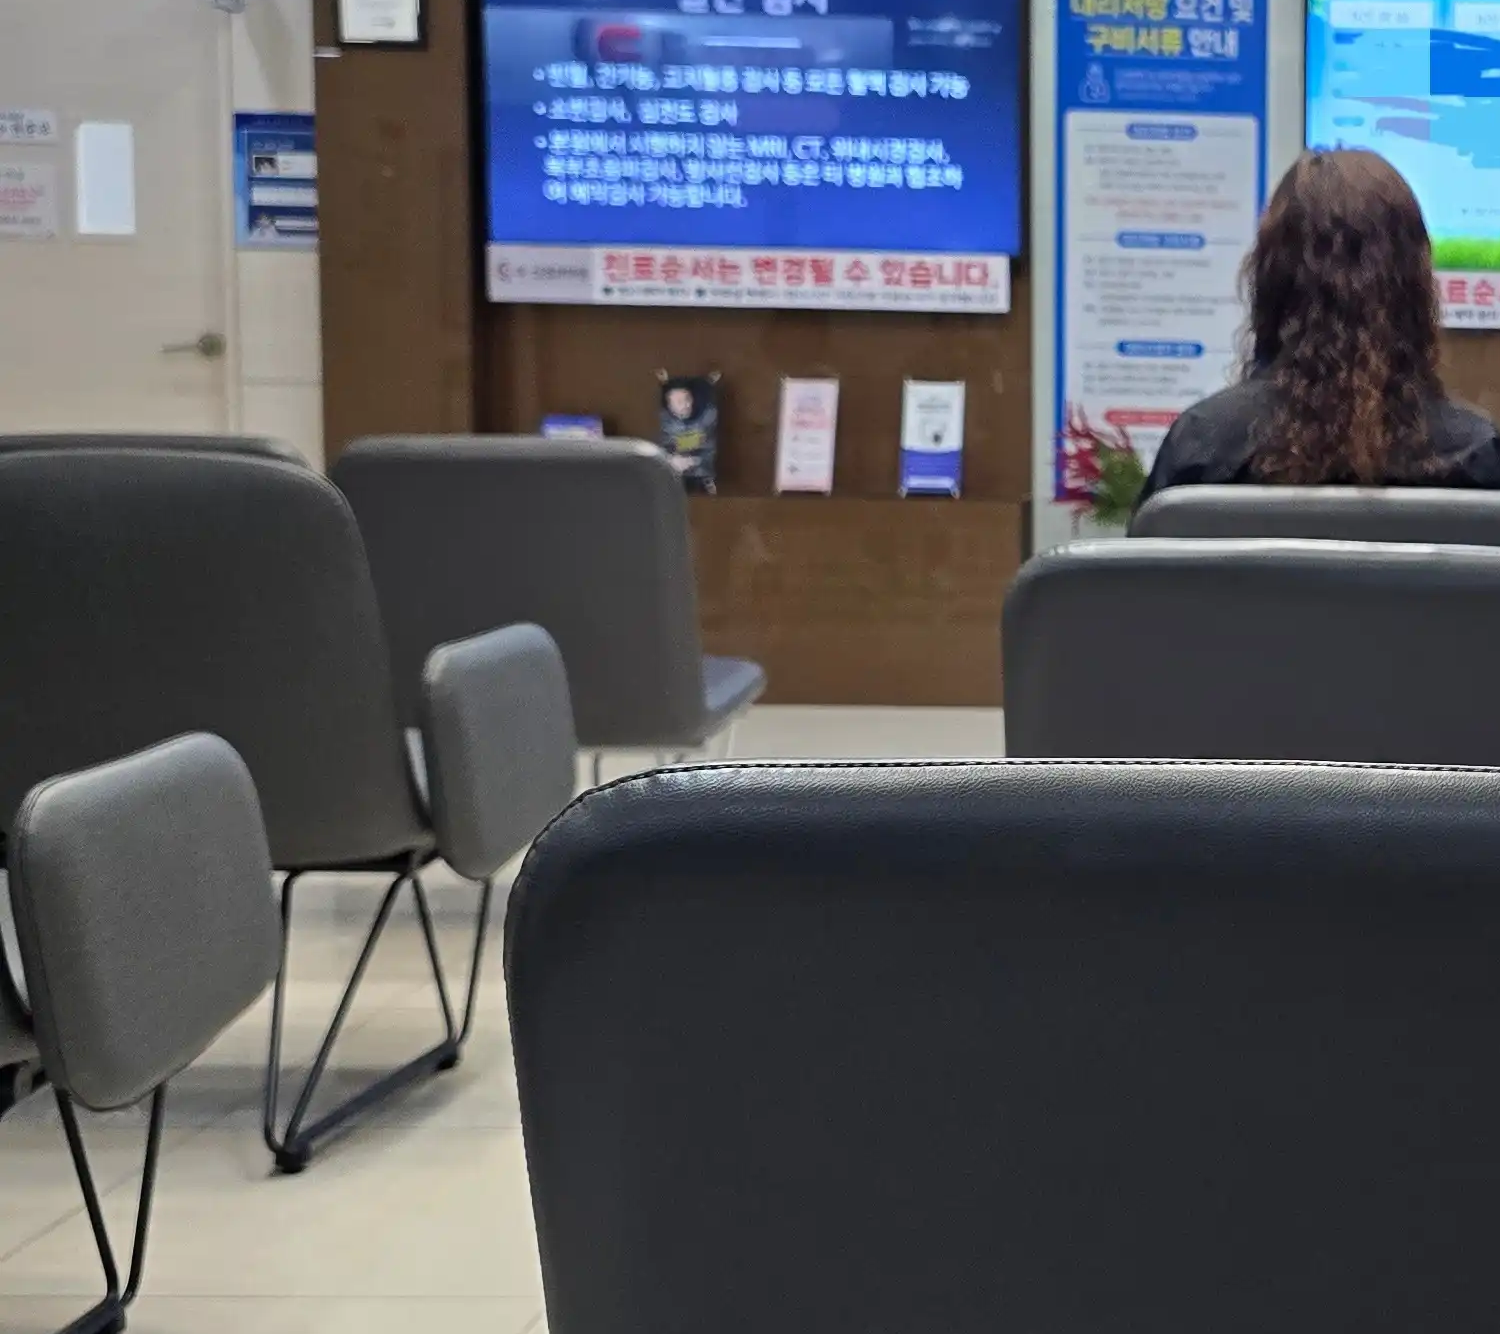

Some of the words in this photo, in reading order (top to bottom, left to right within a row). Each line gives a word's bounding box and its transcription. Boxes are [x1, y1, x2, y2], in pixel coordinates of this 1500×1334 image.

[1085, 23, 1183, 58] 구비서류
[1187, 26, 1240, 59] 안내
[604, 252, 741, 285] 진료순서는
[752, 255, 834, 287] 변경될
[845, 260, 870, 284] 수
